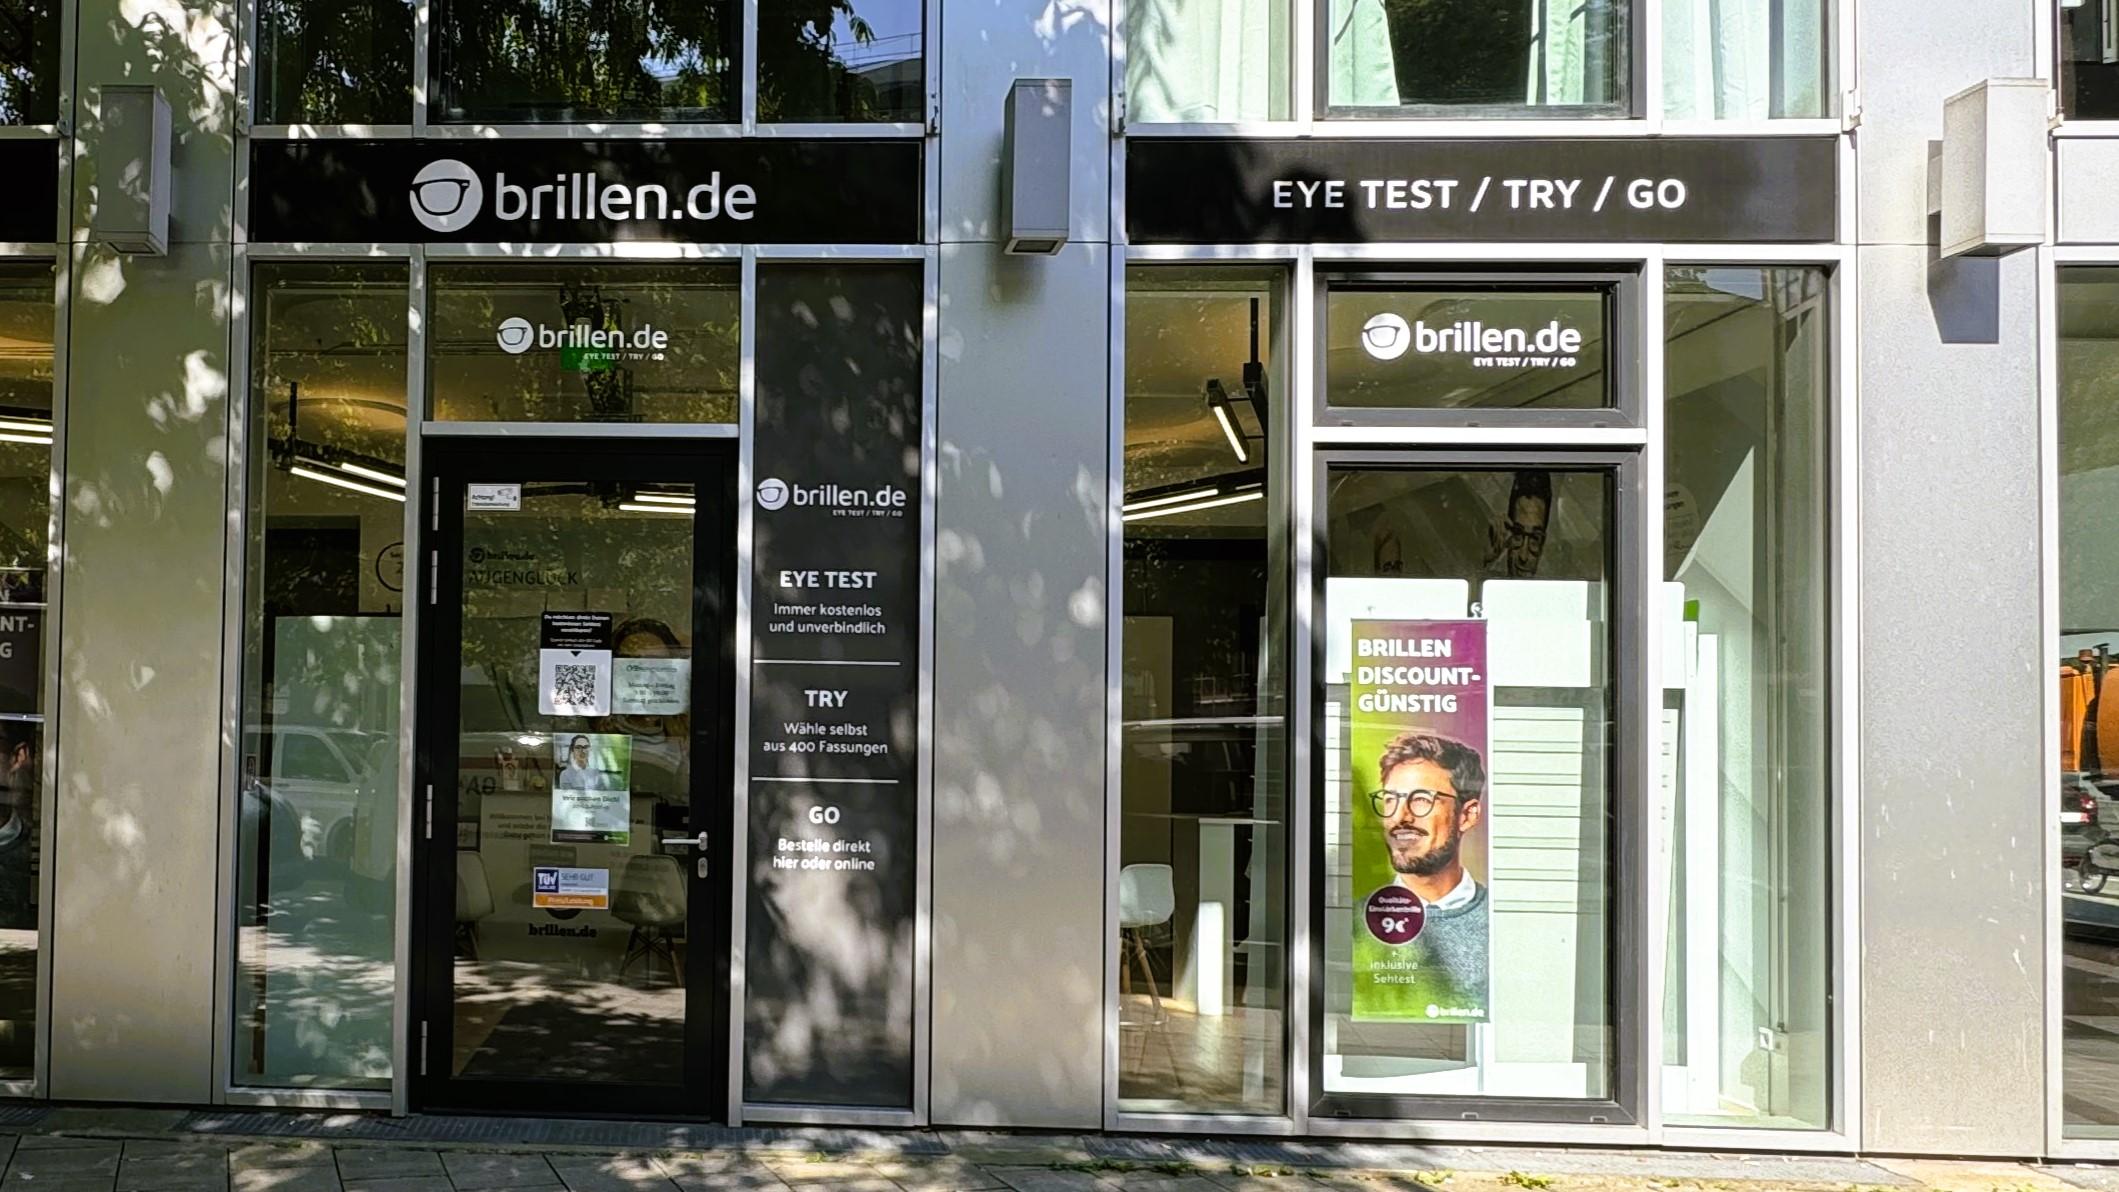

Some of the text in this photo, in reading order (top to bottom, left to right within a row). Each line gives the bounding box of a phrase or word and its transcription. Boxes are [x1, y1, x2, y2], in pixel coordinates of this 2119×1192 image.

[495, 171, 757, 221] brillen.de
[1272, 176, 1687, 212] EYE TEST / TRY / GO
[538, 323, 669, 350] brillen.de
[1415, 320, 1582, 354] brillen.de
[1473, 357, 1494, 368] EYE
[1497, 357, 1521, 367] TEST
[1531, 357, 1551, 367] TRY
[1560, 357, 1577, 367] GO
[792, 484, 907, 507] brillen.de
[779, 570, 877, 589] EYE TEST
[774, 602, 882, 617] Immer kostenlos
[769, 620, 886, 634] und unverbindlich
[1357, 638, 1452, 658] BRILLEN
[1357, 666, 1482, 686] DISCOUNT-
[804, 690, 848, 708] TRY
[1357, 688, 1458, 713] GÜNSTIG
[784, 722, 868, 737] Wähle selbst
[763, 741, 889, 757] aus 400 Fassungen
[808, 806, 841, 824] GO
[778, 838, 872, 853] Bestelle direkt
[773, 856, 875, 871] hier oder online
[537, 871, 558, 885] TÜV
[527, 922, 598, 938] brillen.de
[1373, 973, 1416, 984] Sehtest
